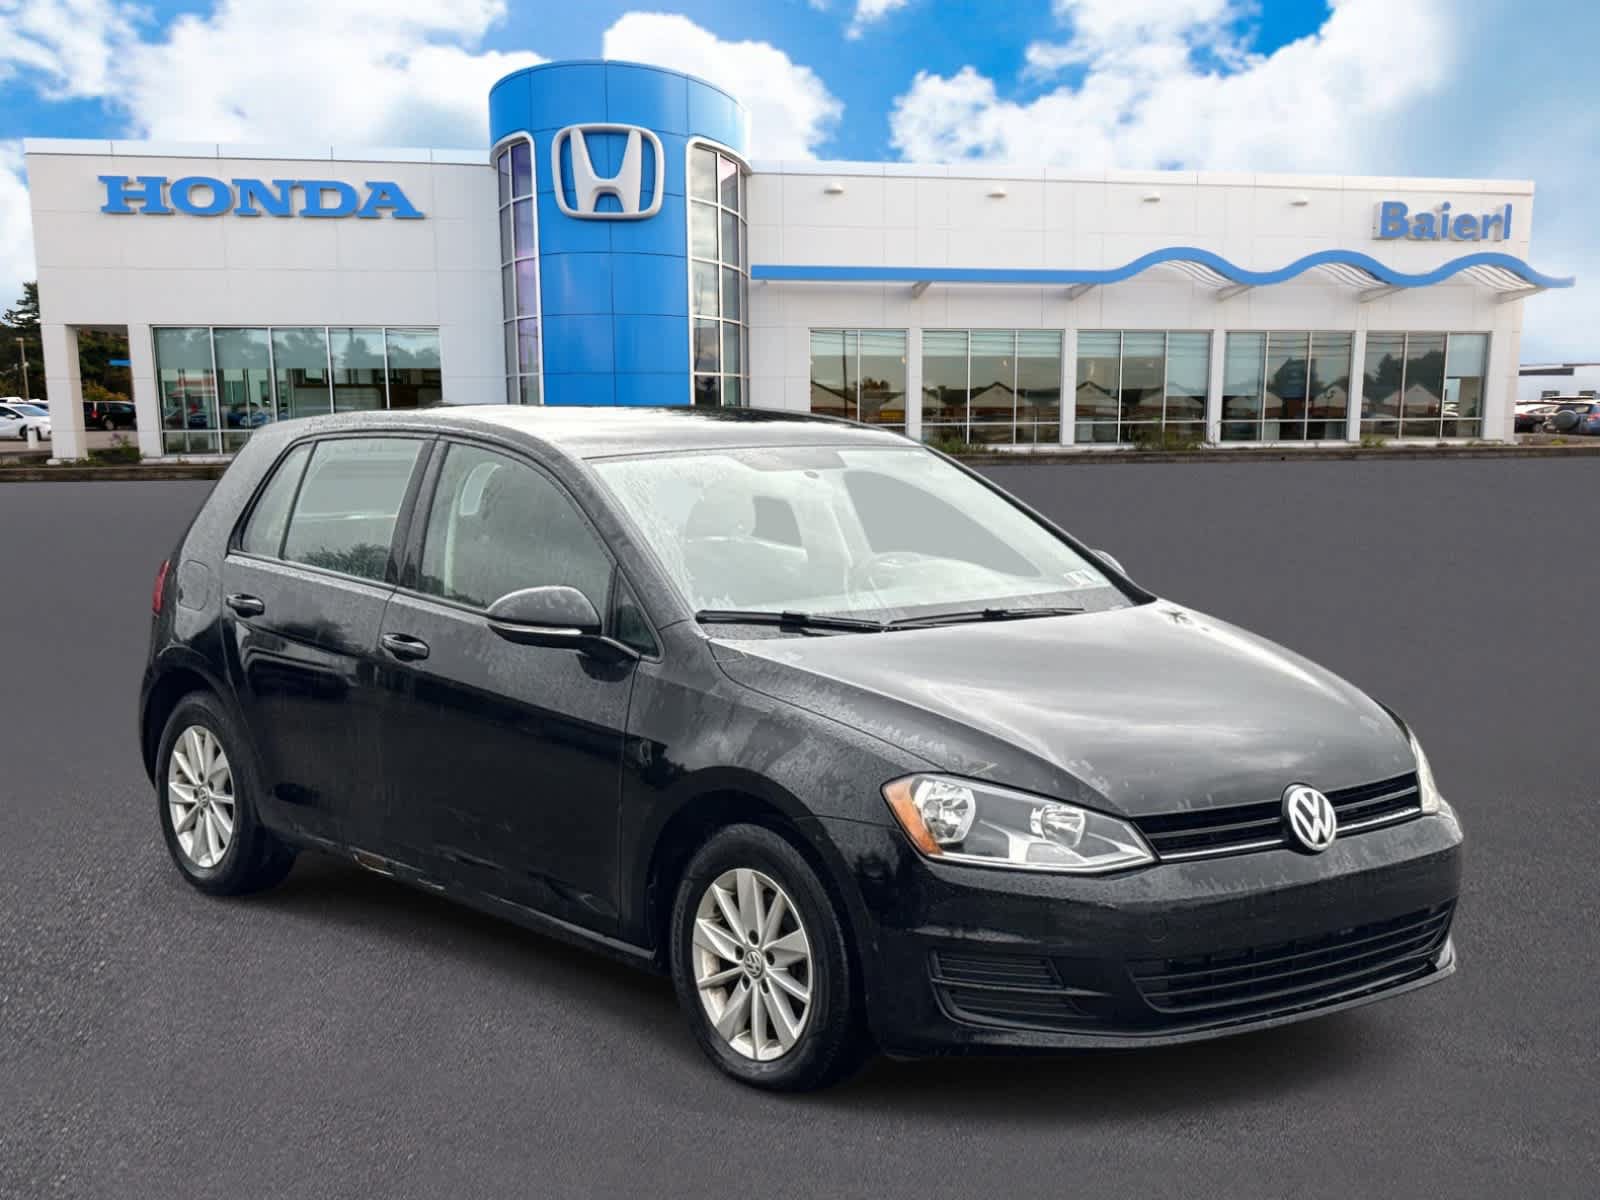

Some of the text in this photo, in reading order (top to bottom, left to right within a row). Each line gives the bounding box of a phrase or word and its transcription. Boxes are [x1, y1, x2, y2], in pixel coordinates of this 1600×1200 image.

[98, 175, 424, 218] HONDA
[1380, 200, 1512, 240] Baierl
[1289, 789, 1336, 848] VW
